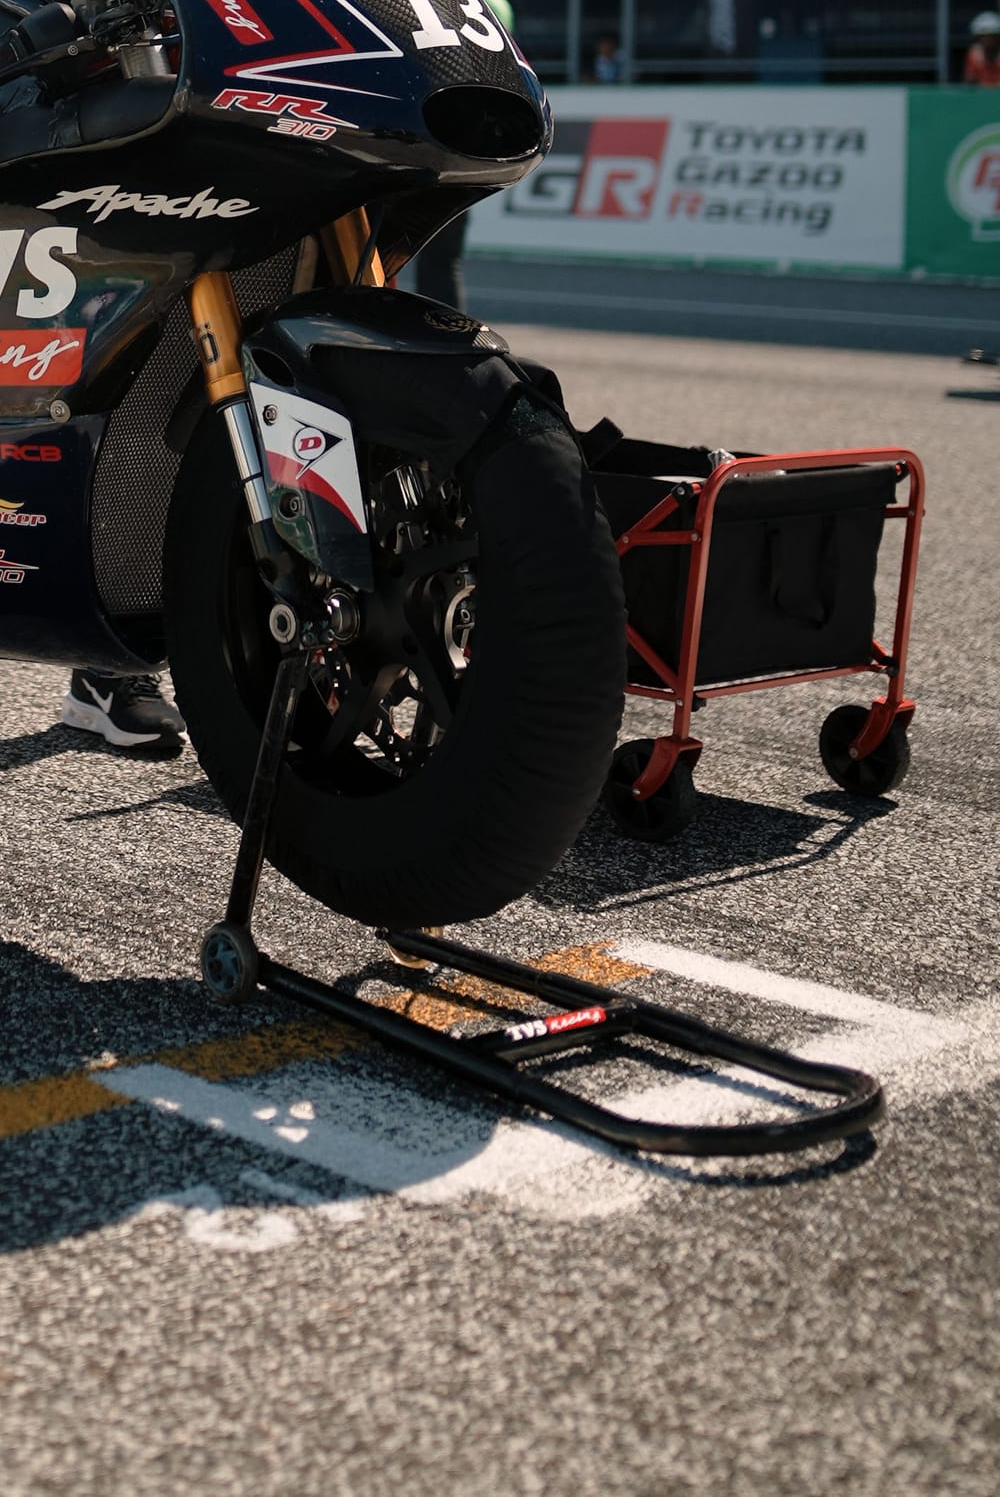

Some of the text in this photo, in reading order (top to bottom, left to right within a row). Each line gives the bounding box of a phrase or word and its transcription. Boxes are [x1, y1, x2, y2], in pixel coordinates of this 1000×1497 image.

[213, 88, 359, 129] RR
[267, 120, 337, 142] 310
[684, 120, 868, 157] TOYOTA
[507, 143, 664, 220] GR
[674, 156, 846, 193] GAZOO
[36, 184, 260, 224] Apache
[666, 189, 833, 238] Racing
[0, 443, 63, 463] RCB
[506, 1019, 548, 1042] TVS
